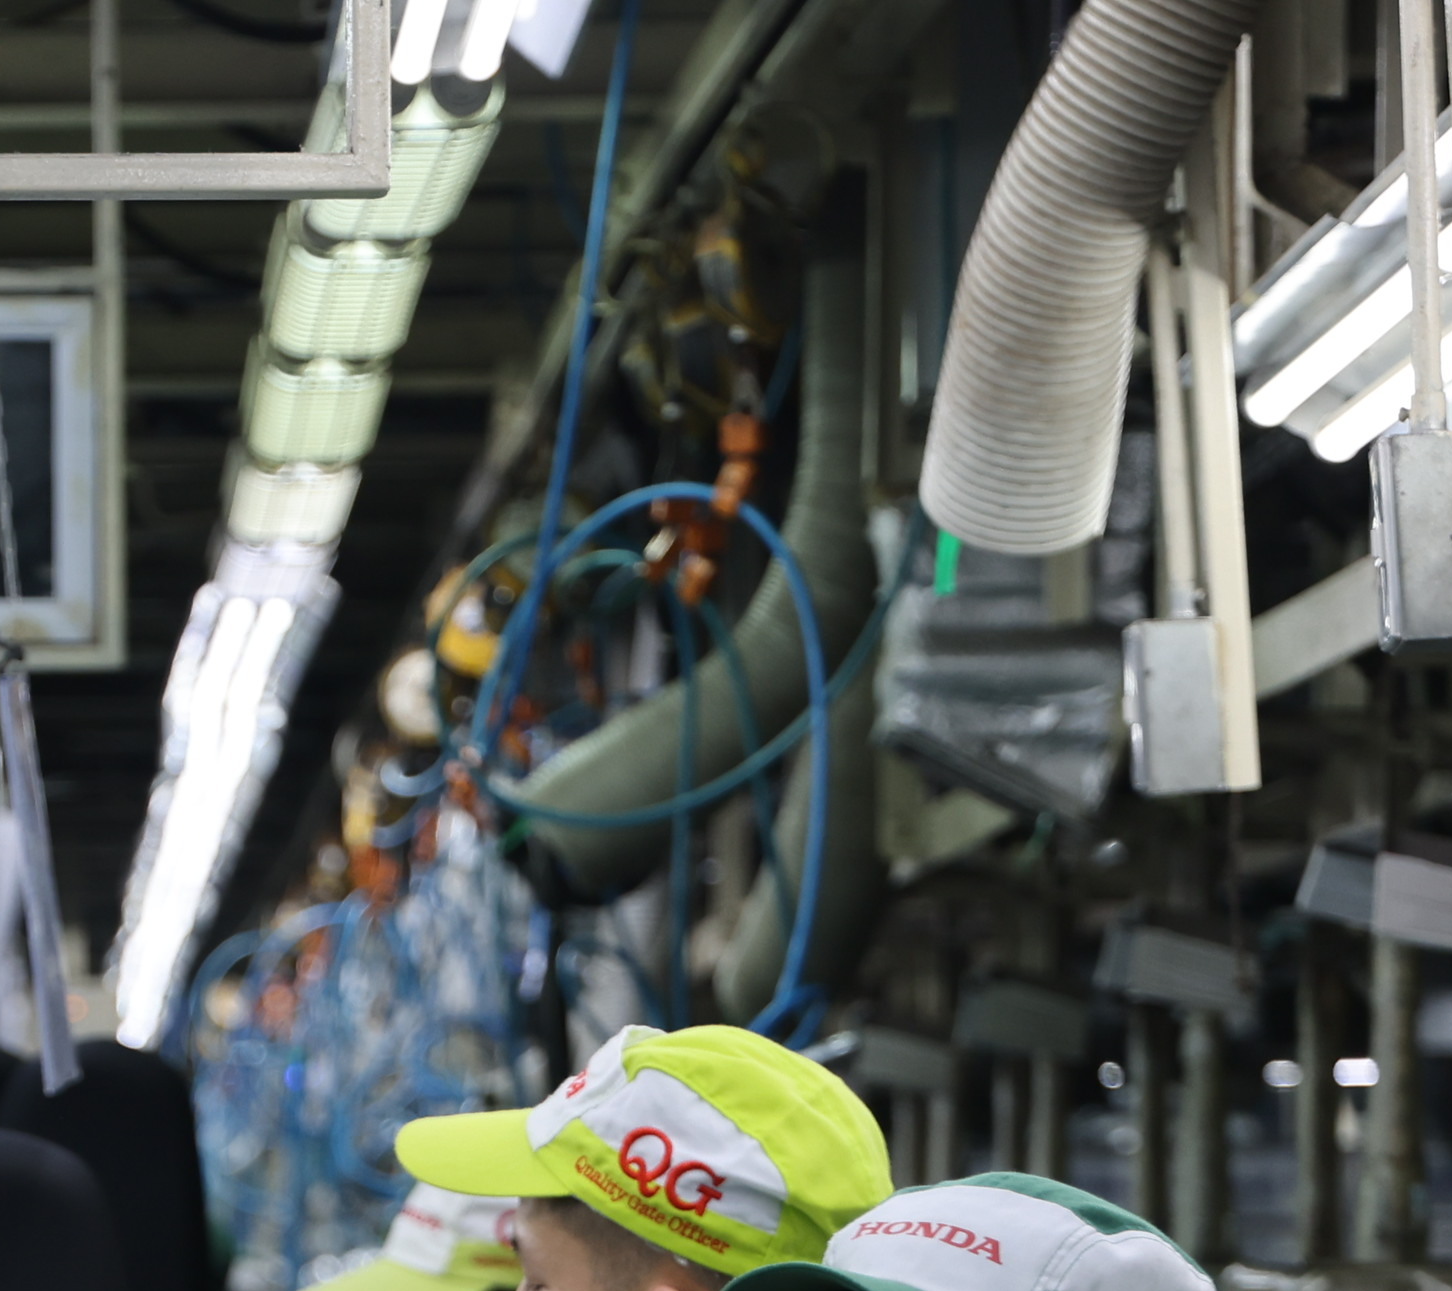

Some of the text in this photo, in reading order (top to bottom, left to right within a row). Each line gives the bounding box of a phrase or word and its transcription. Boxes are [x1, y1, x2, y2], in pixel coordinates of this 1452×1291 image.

[575, 1155, 731, 1254] Quality Gate Officer
[619, 1126, 726, 1217] QG
[851, 1221, 1003, 1265] HONDA
